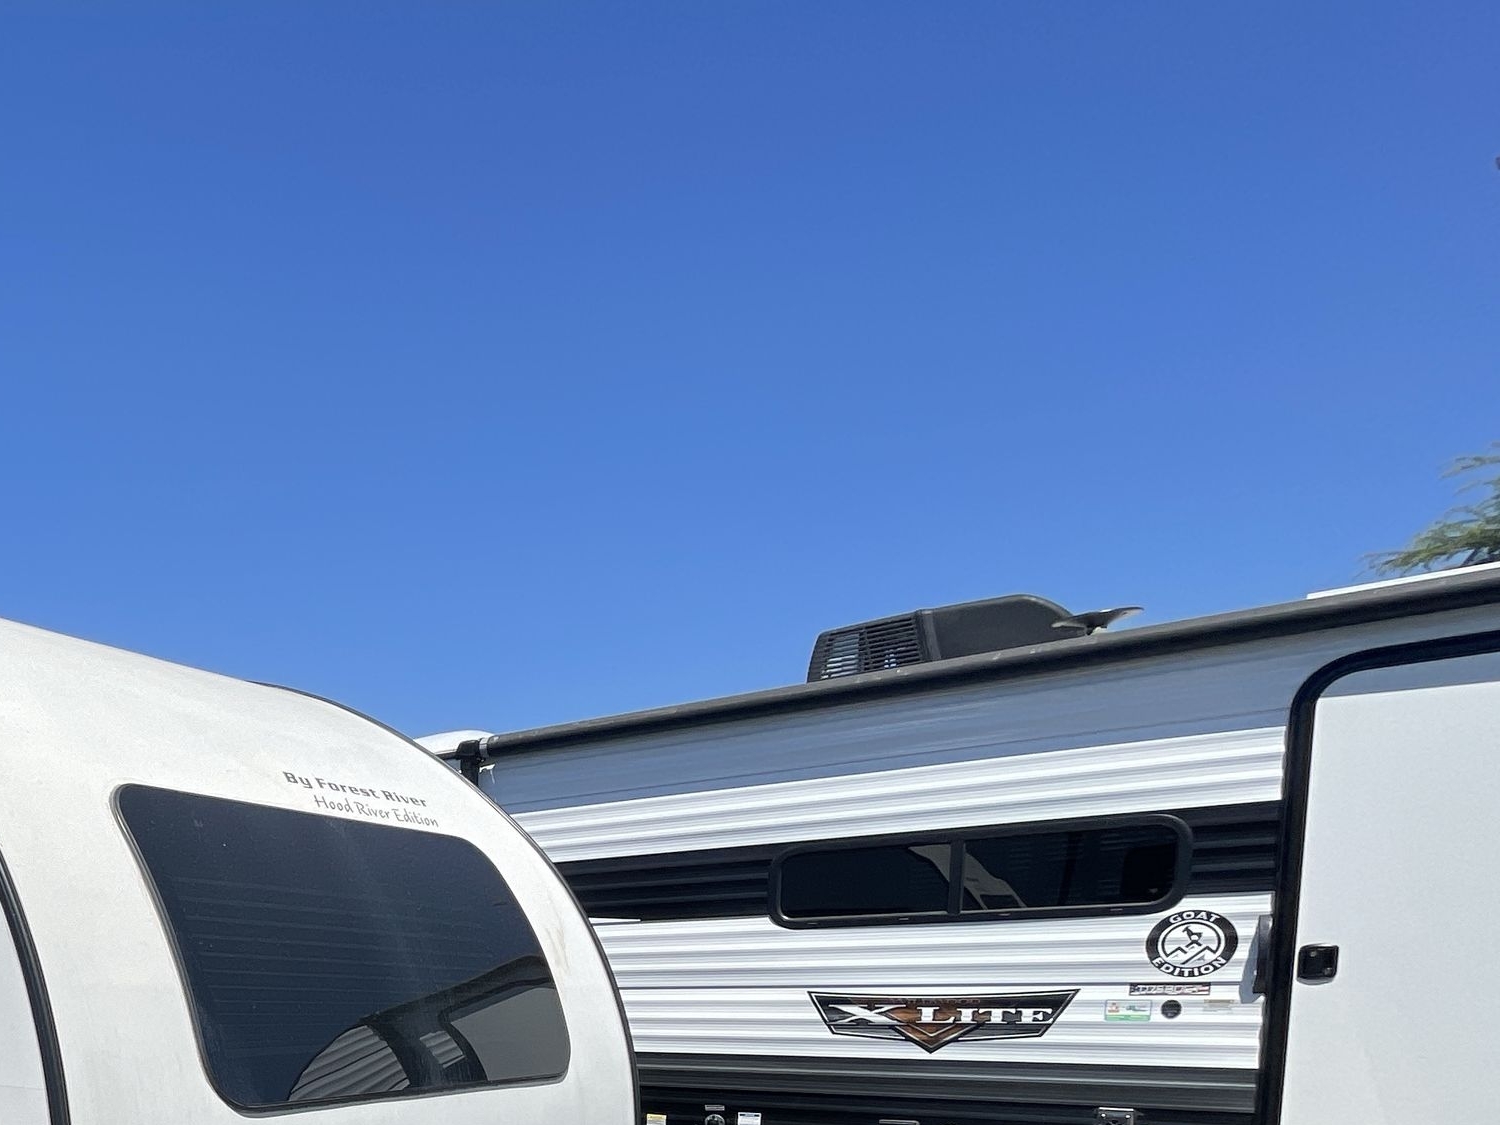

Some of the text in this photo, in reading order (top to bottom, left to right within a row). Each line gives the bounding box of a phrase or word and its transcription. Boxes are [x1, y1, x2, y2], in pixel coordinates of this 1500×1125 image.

[283, 771, 428, 807] By Forest River
[313, 794, 439, 828] Hood River Edition
[1169, 911, 1221, 924] GOAT
[1151, 956, 1227, 977] EDITION
[915, 1006, 1055, 1025] LITE
